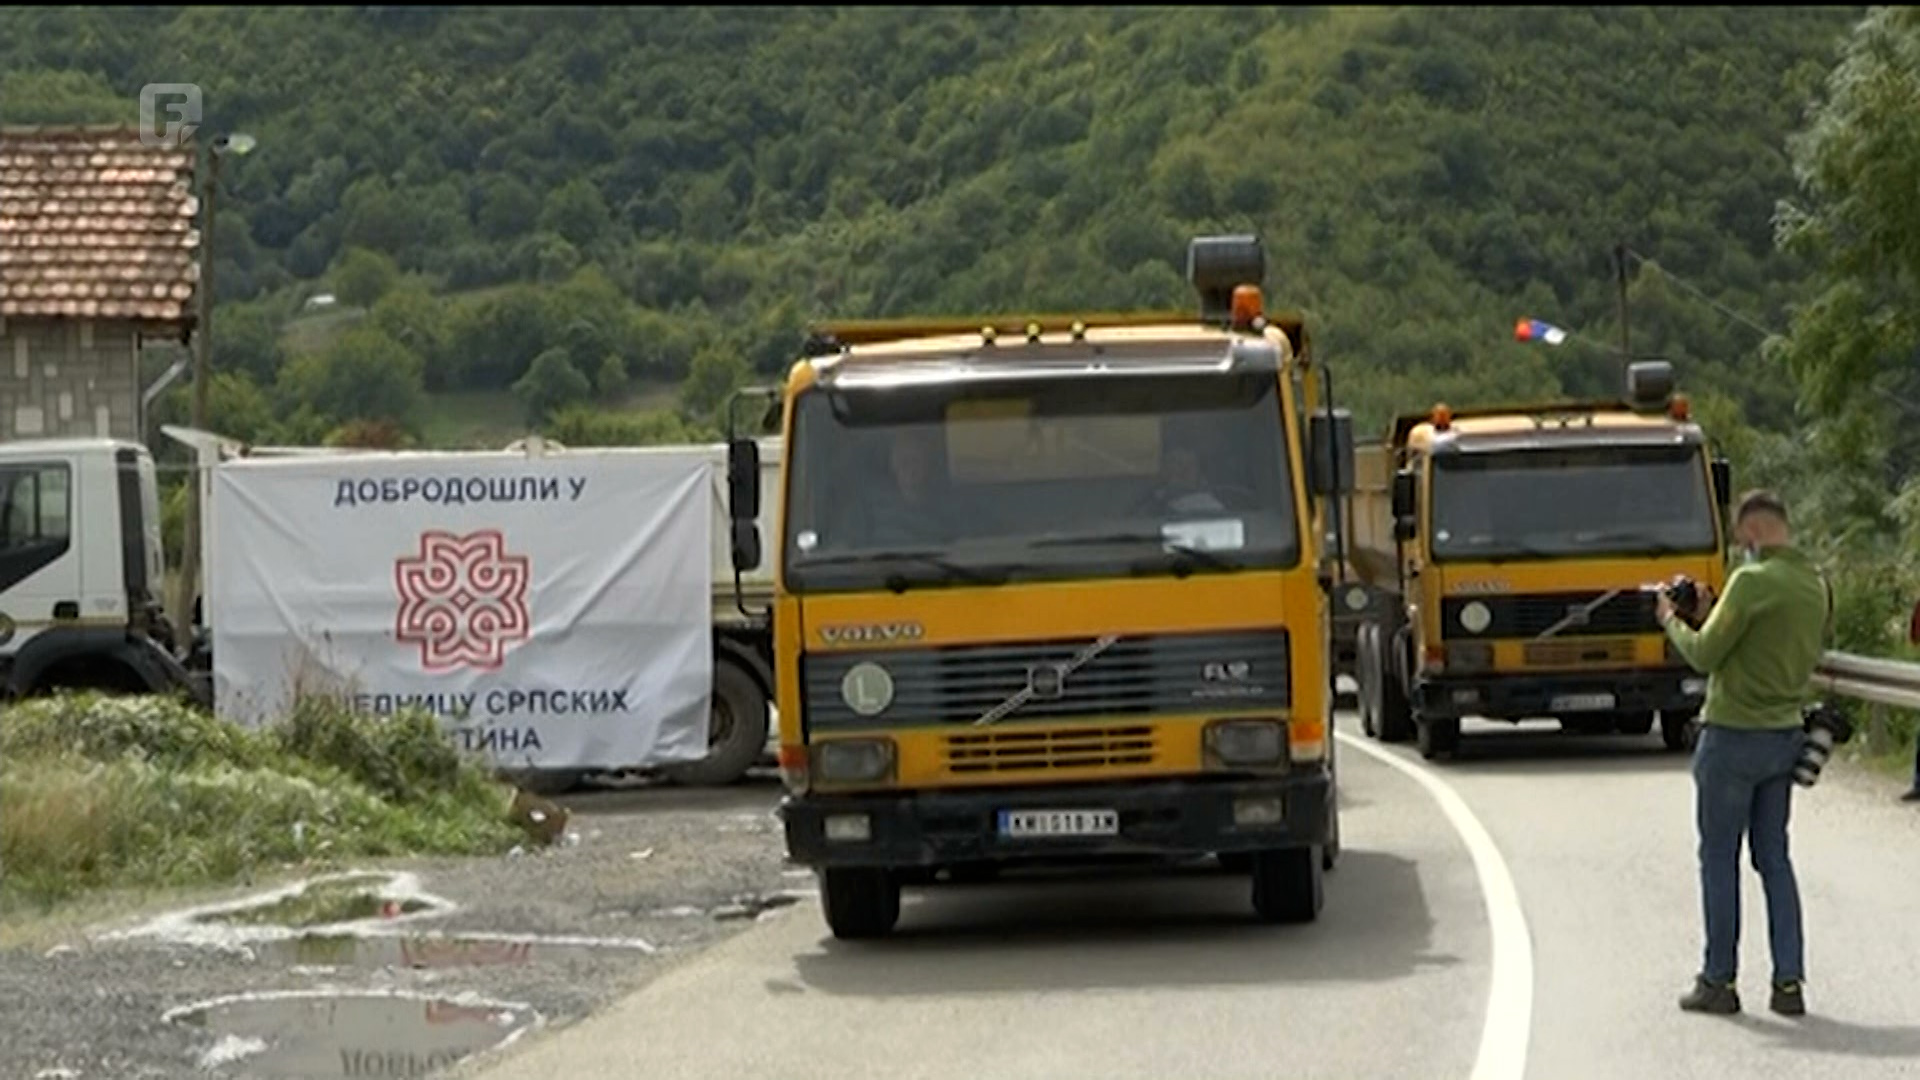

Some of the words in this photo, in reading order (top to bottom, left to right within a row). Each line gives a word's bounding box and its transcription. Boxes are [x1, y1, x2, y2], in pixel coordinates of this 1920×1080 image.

[334, 477, 559, 506] ДОБРОДОШЛИ
[567, 477, 587, 500] У
[820, 623, 922, 642] VOLVO
[486, 689, 628, 715] СРПСКИХ
